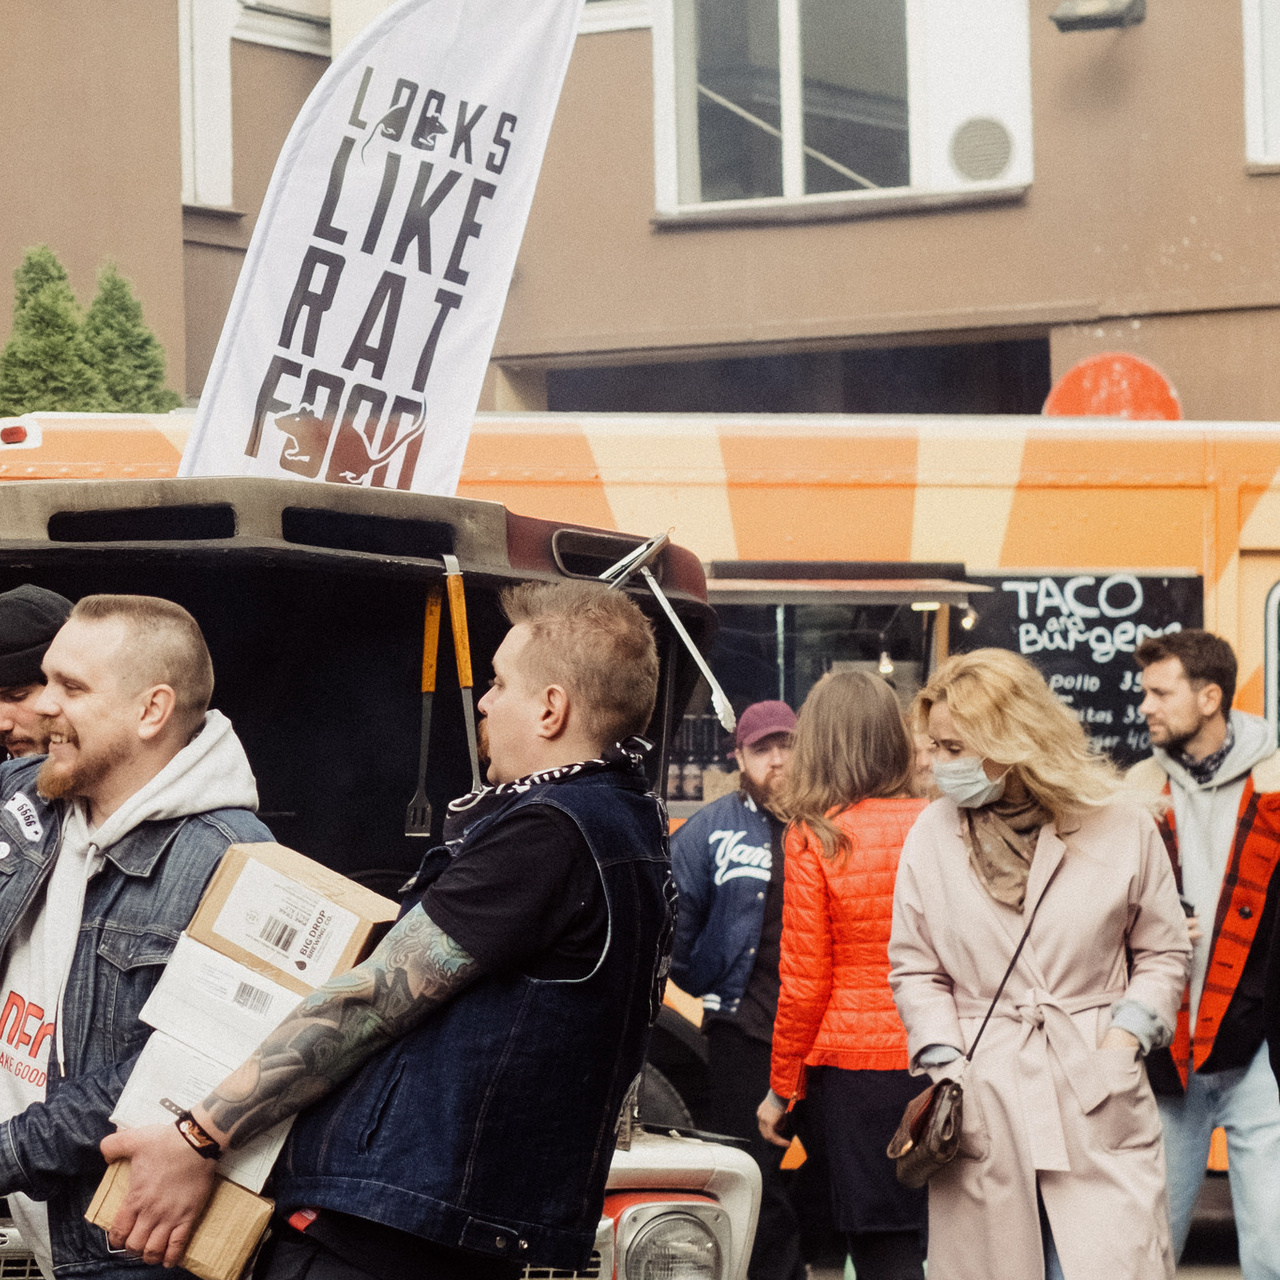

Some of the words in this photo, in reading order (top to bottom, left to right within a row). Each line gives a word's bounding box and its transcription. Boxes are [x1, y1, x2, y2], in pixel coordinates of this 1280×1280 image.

[348, 66, 517, 175] LOOKS
[313, 136, 497, 286] LIKE
[278, 245, 463, 393] RAT
[244, 354, 426, 491] FOOD
[1002, 574, 1144, 619] TACO
[300, 938, 313, 956] BIG
[309, 910, 326, 938] DROP
[14, 1061, 47, 1087] GOOD
